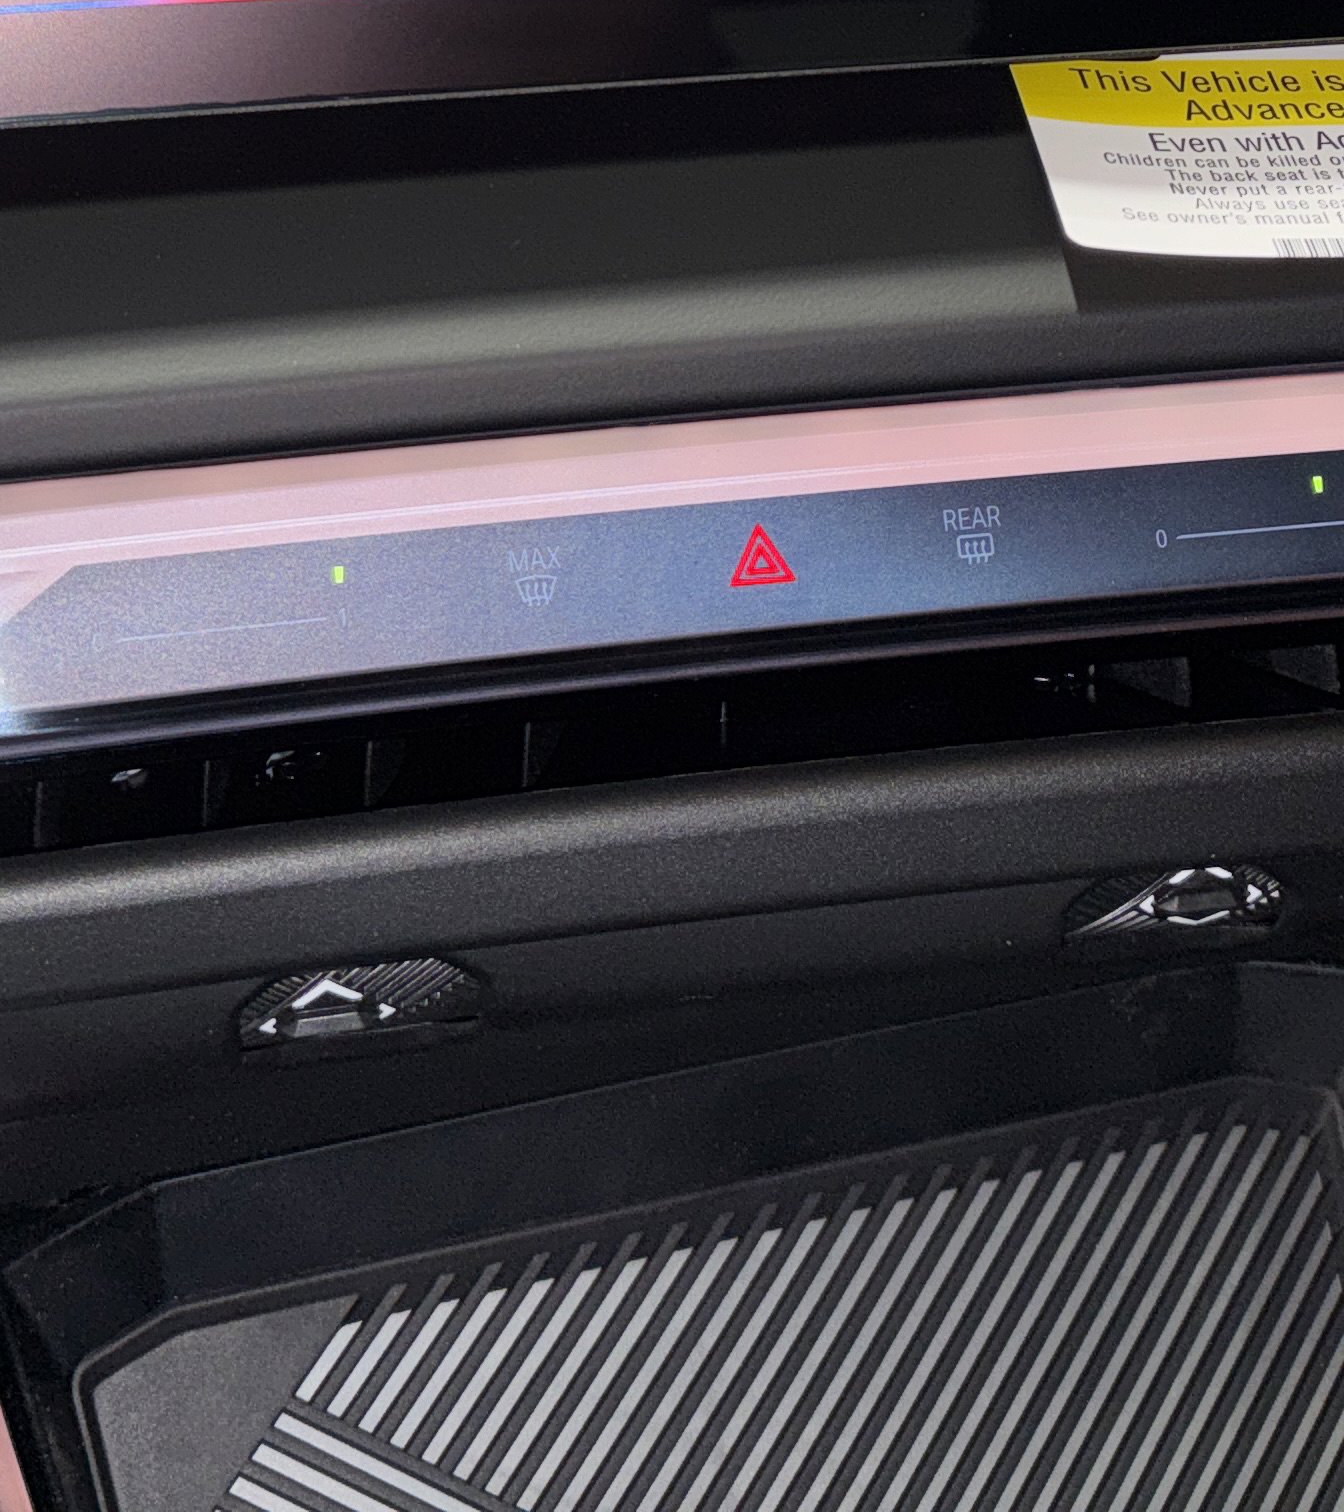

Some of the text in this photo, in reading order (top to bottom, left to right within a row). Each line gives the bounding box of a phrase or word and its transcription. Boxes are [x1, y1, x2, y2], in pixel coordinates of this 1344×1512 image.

[1069, 66, 1153, 93] This
[1160, 69, 1302, 94] Vehicle
[1148, 132, 1228, 154] Even
[1234, 131, 1306, 153] with
[1103, 152, 1188, 169] Children
[1194, 156, 1230, 168] can
[1236, 154, 1261, 168] be
[1268, 154, 1322, 168] killed
[1165, 169, 1204, 183] The
[1210, 168, 1264, 182] back
[1264, 169, 1308, 182] seat
[1312, 167, 1332, 181] is
[1169, 182, 1228, 196] Never
[1237, 183, 1273, 198] put
[1276, 185, 1288, 195] a
[1195, 197, 1266, 212] Always
[1274, 199, 1310, 210] use
[1121, 207, 1160, 223] See
[1167, 211, 1248, 225] owner's
[1254, 210, 1330, 225] manual
[942, 504, 1002, 533] REAR
[1155, 528, 1169, 549] 0
[506, 544, 563, 571] MAX
